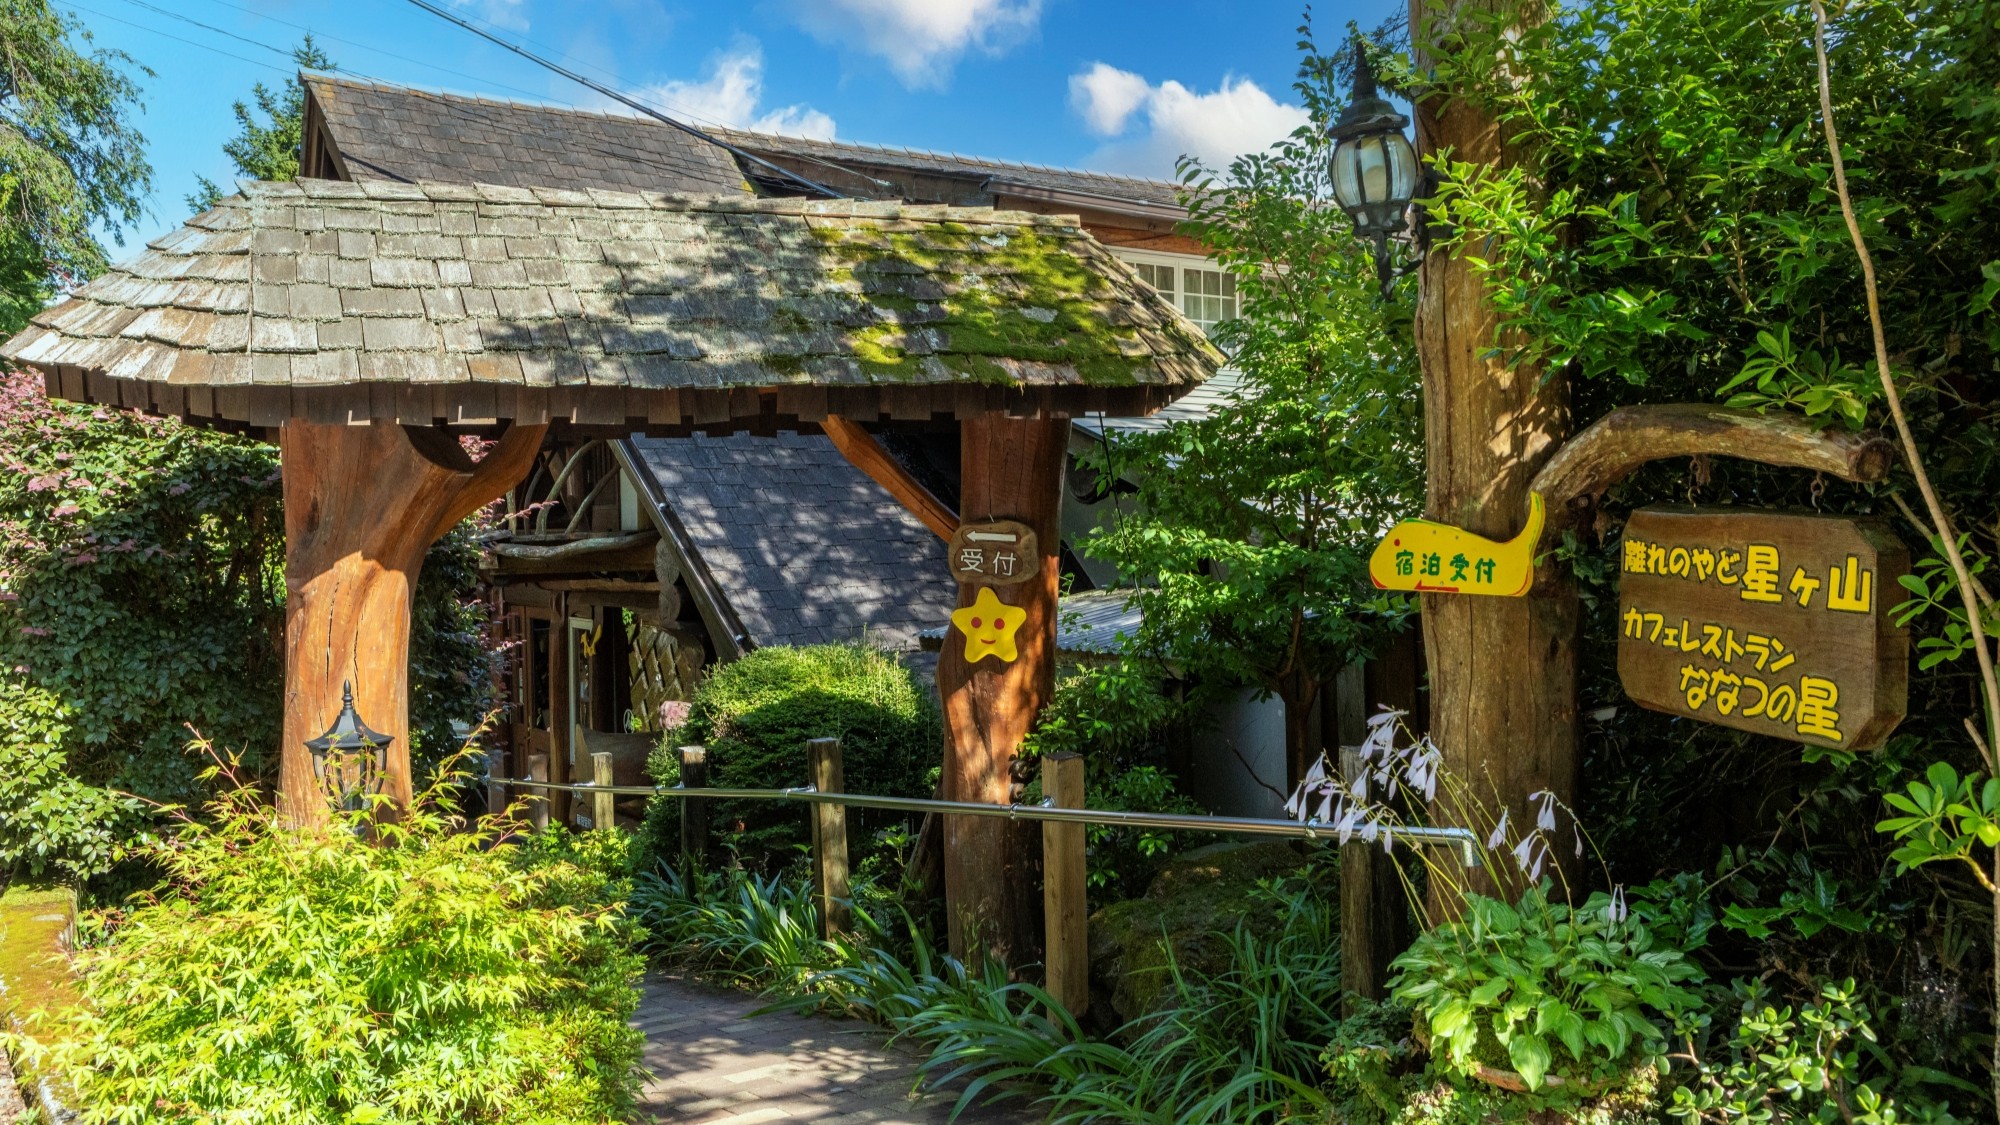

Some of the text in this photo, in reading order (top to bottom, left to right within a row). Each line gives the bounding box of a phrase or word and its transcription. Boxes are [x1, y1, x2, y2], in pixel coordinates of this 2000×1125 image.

[960, 548, 1016, 576] 受付
[1395, 549, 1497, 584] 宿泊受付
[1623, 606, 1796, 673] カフェレストラン
[1679, 663, 1843, 742] ななつの星
